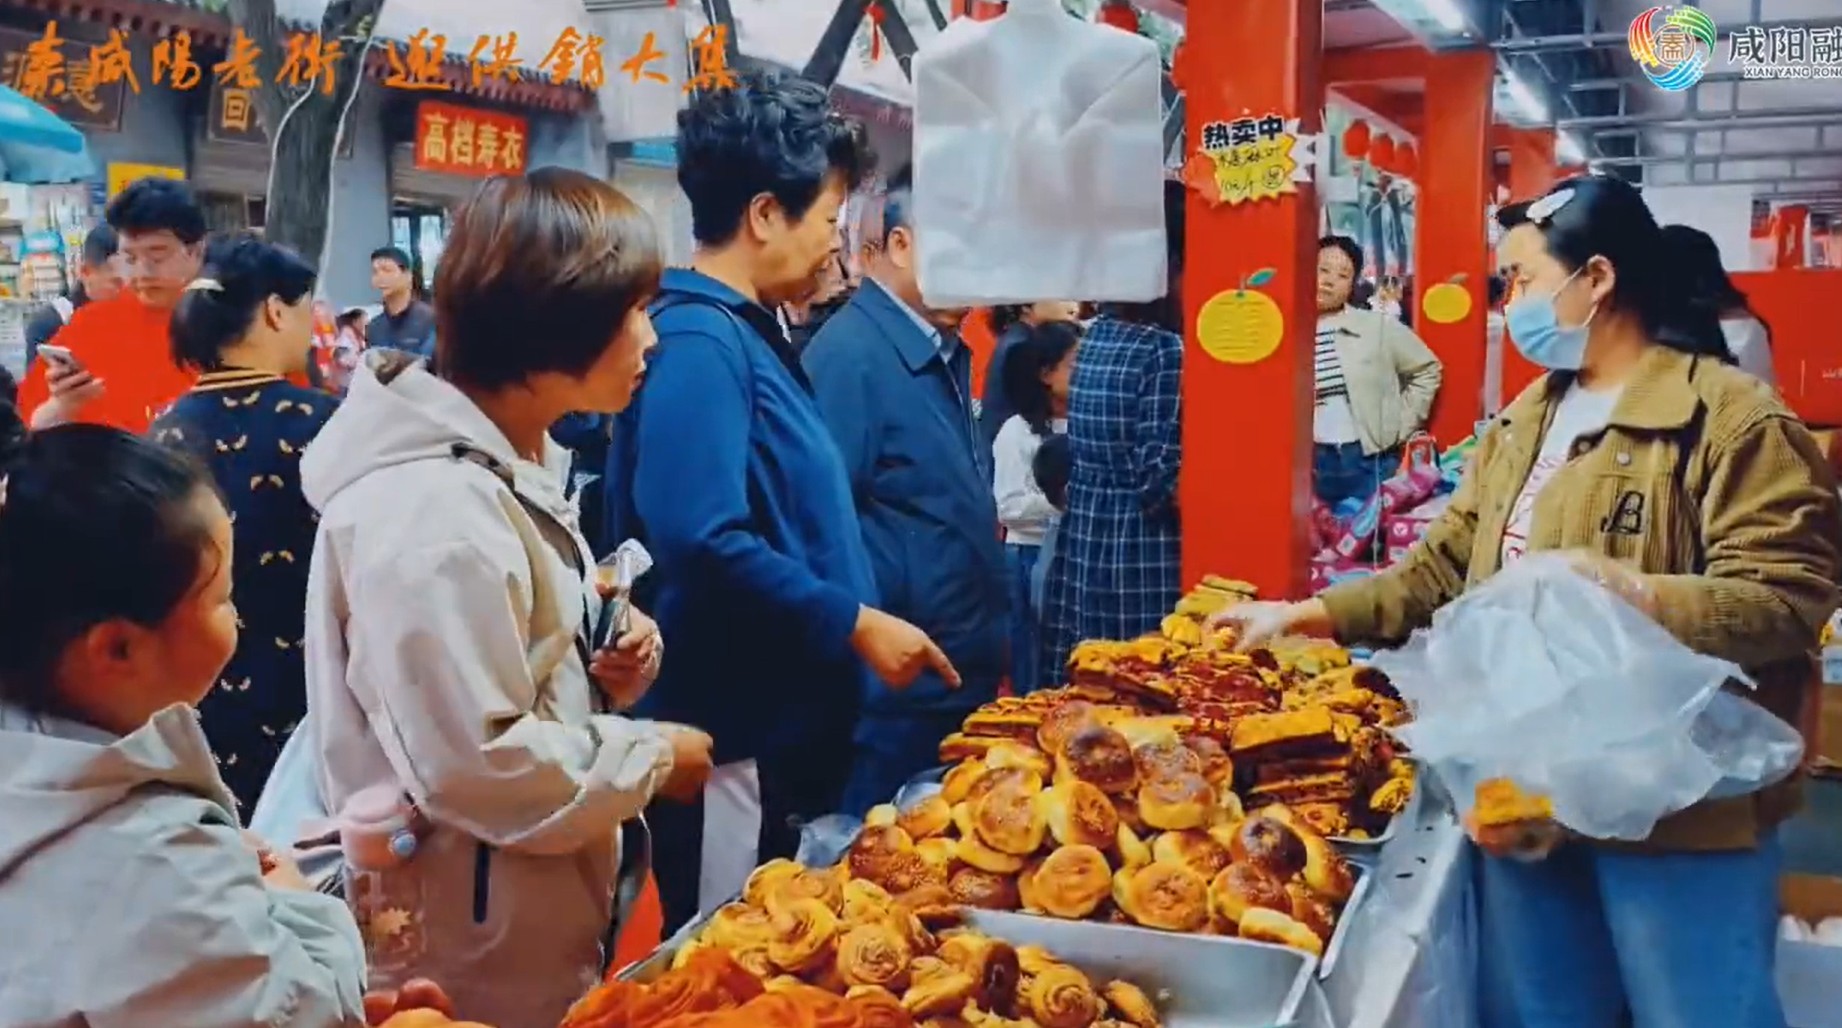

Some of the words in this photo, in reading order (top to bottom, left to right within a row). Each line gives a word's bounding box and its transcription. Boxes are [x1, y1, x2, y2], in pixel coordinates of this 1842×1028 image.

[422, 112, 524, 170] 高档寿衣
[1203, 114, 1283, 150] 热卖中
